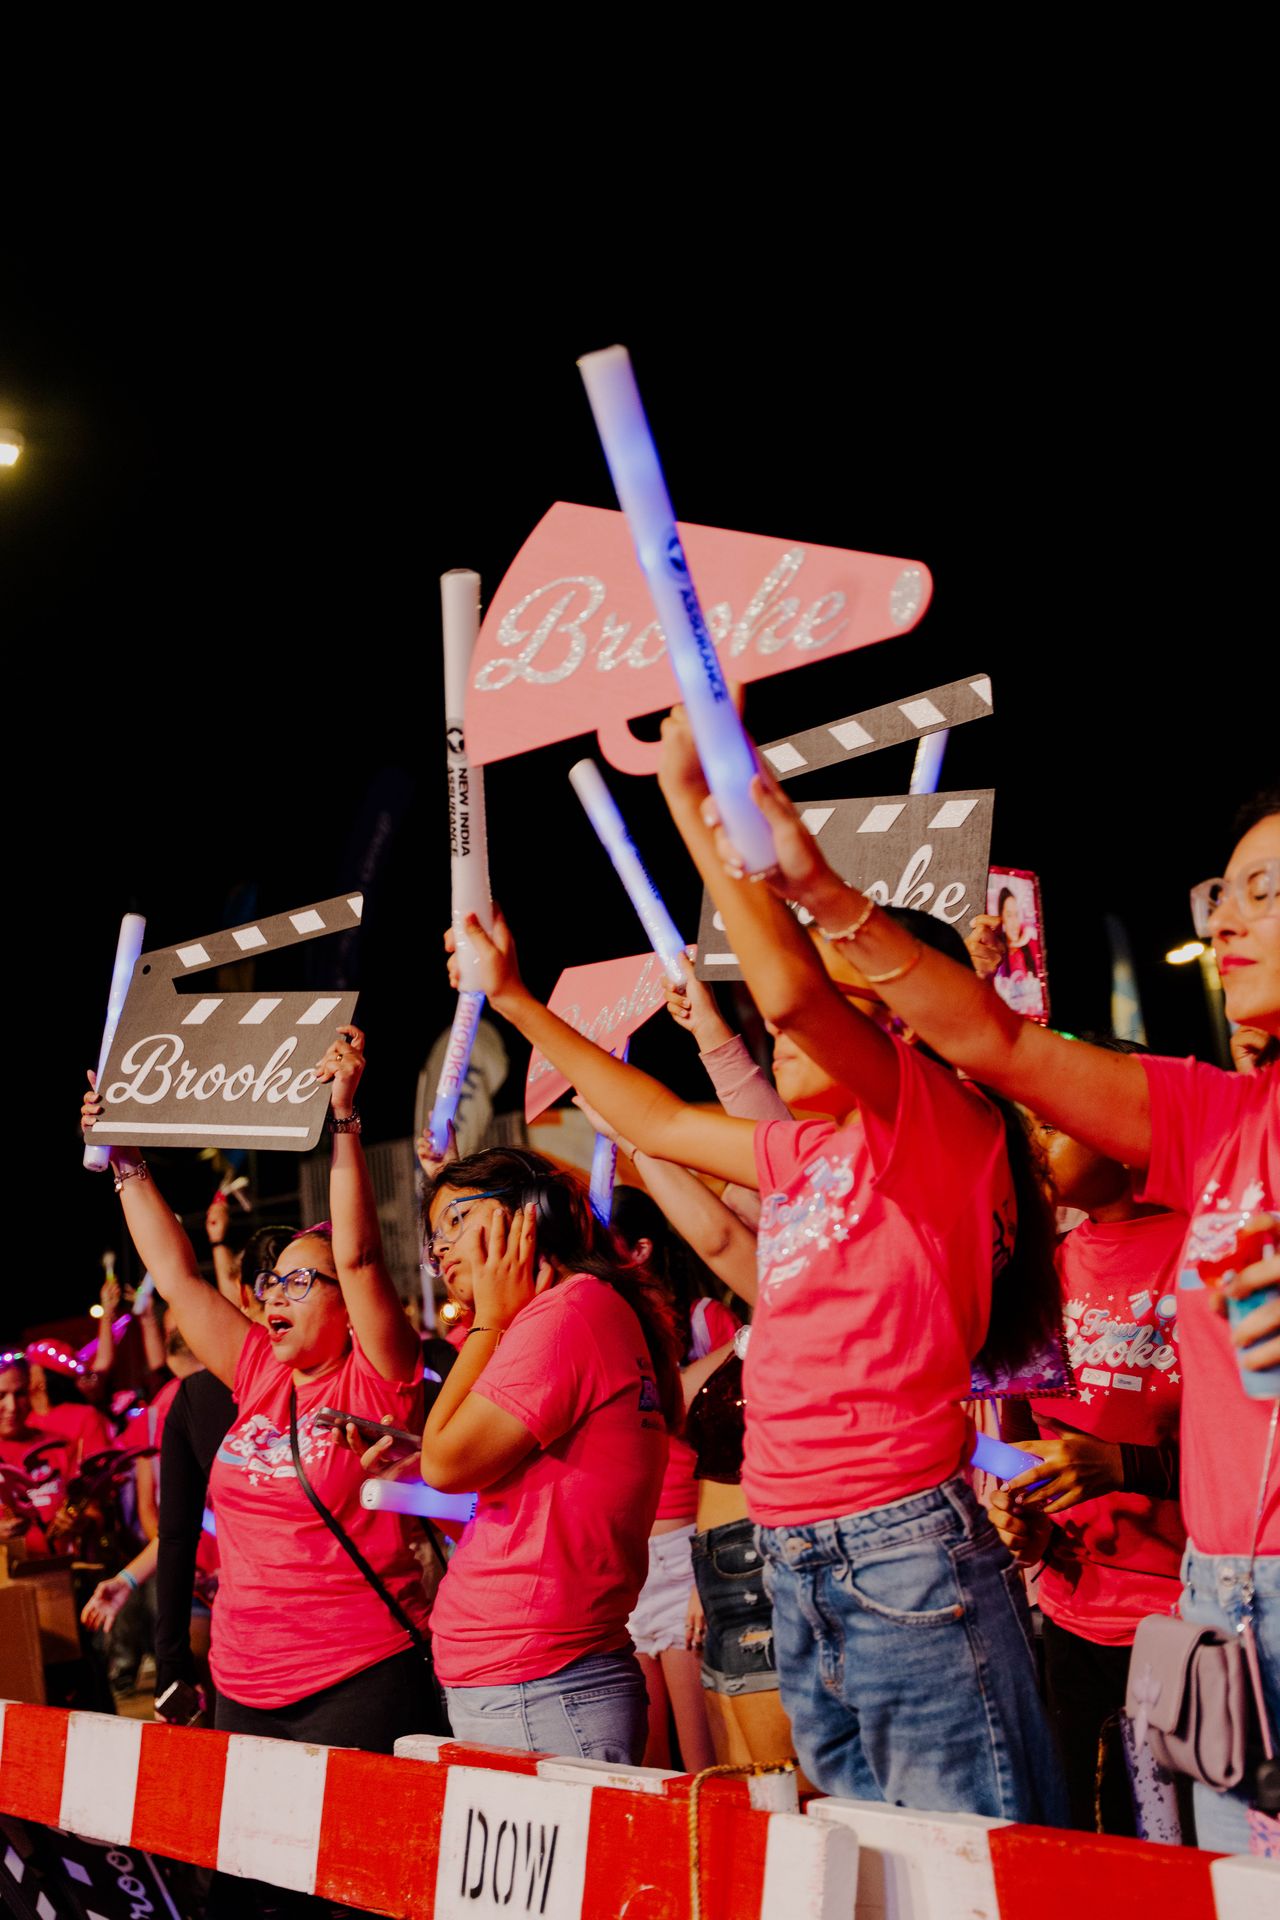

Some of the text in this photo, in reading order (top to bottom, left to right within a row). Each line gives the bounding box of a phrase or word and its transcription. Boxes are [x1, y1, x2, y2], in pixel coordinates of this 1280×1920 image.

[680, 588, 727, 702] ASSURANCE
[458, 767, 471, 857] NEW INDIA
[105, 1033, 320, 1105] Brooke
[1067, 1324, 1178, 1371] rooke
[461, 1808, 559, 1914] DOW
